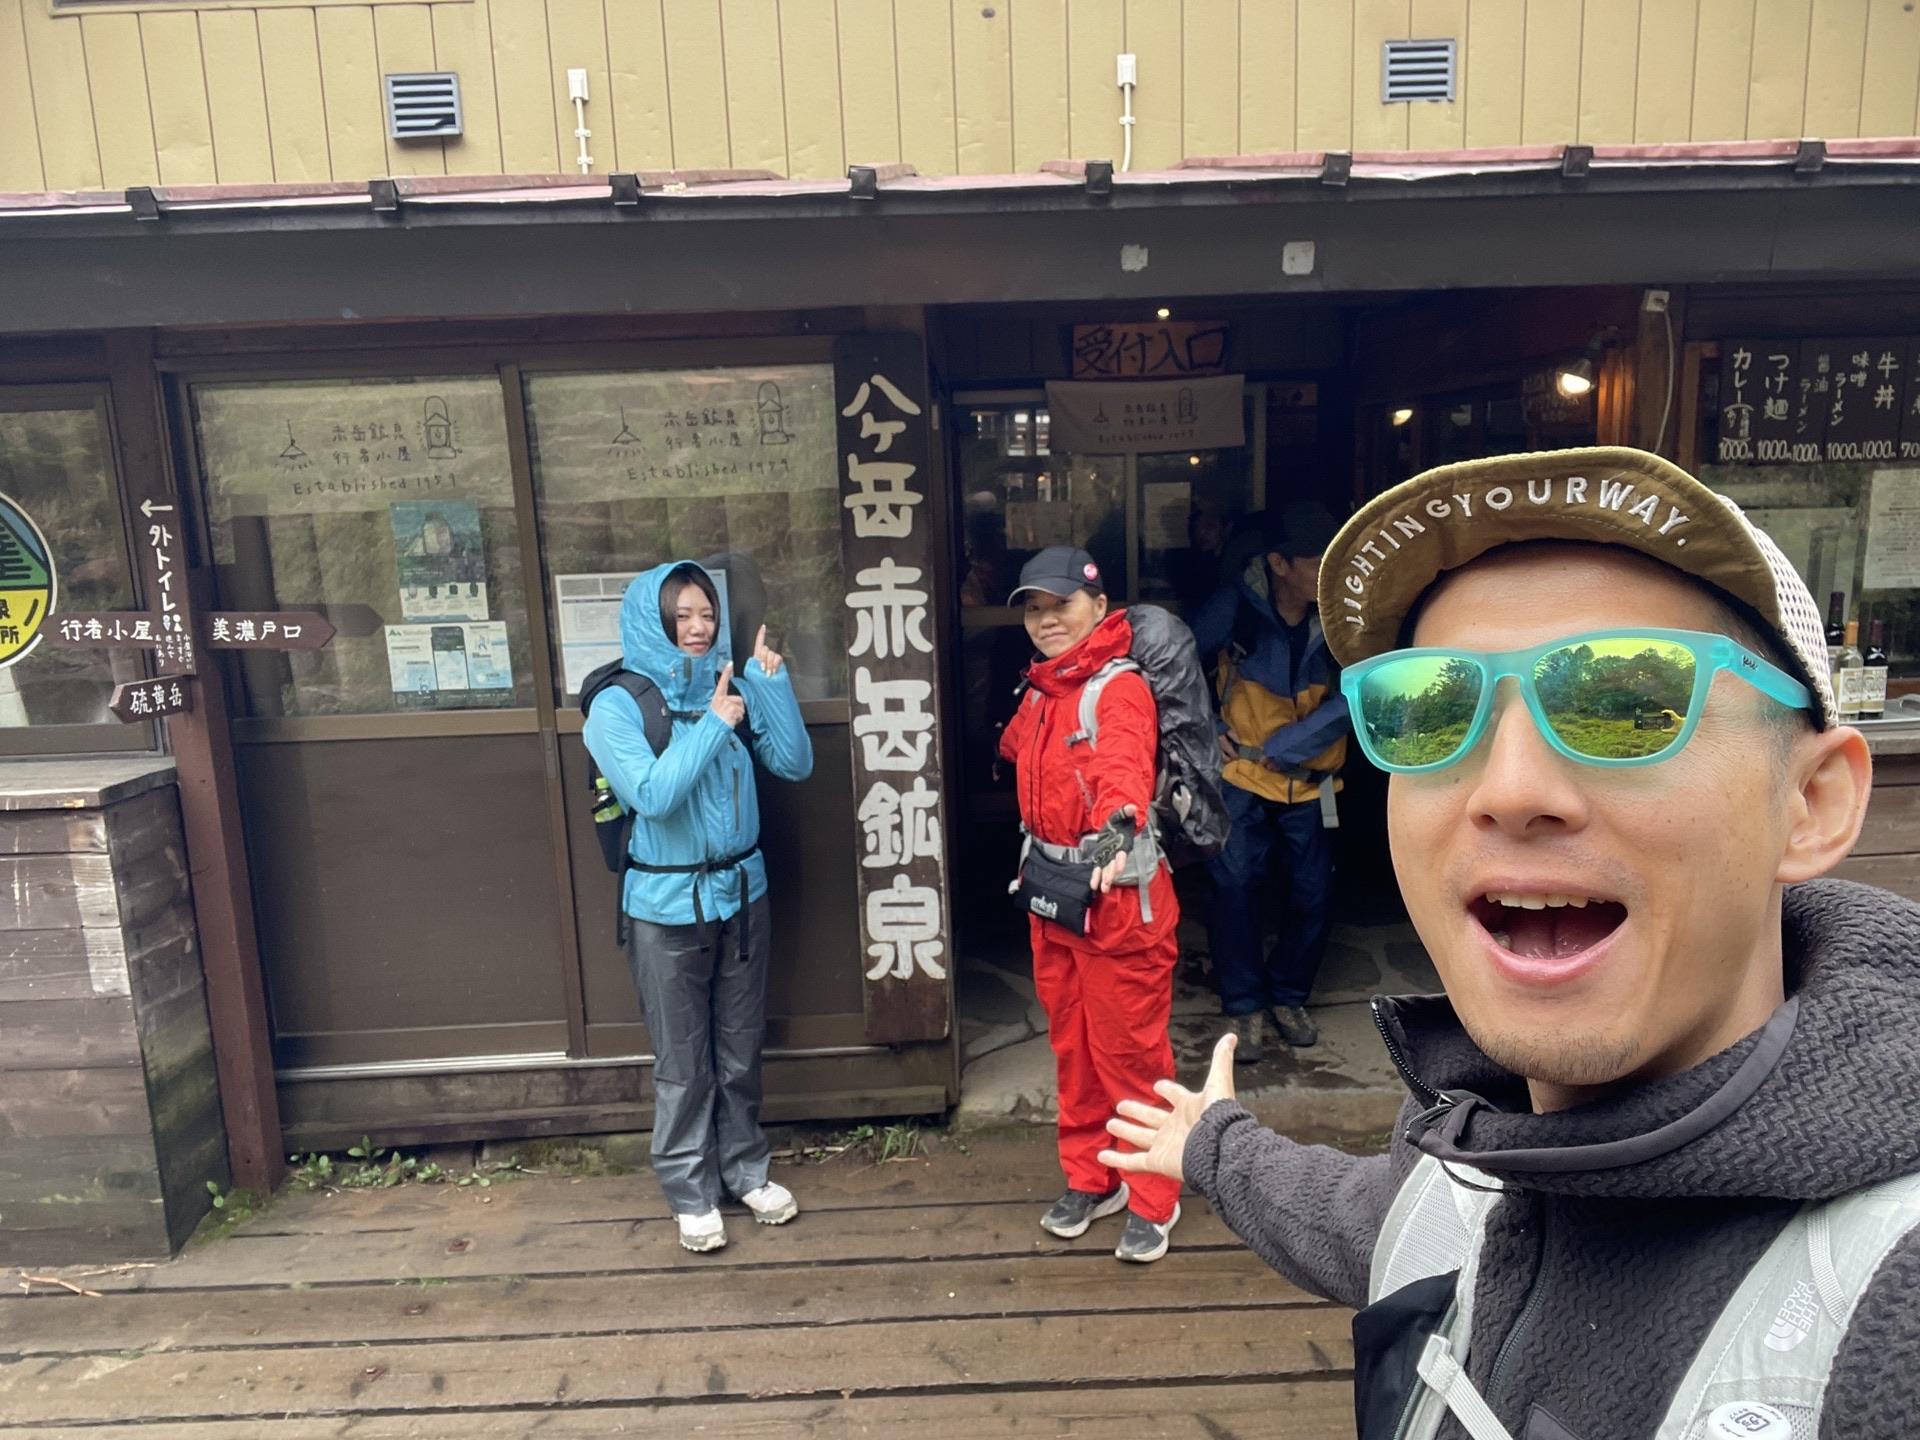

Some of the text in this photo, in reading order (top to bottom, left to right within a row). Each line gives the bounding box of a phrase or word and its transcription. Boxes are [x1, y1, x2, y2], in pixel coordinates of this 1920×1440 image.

[1074, 326, 1229, 375] 受付入口
[1831, 372, 1847, 426] ラーメン
[1874, 351, 1899, 410] 牛丼
[149, 524, 176, 612] 外トイレ
[60, 618, 153, 641] 行者小屋
[212, 618, 302, 642] 美濃戸口
[130, 683, 183, 714] 硫黄岳
[1777, 1280, 1807, 1320] FACE
[1789, 1282, 1817, 1326] ORTH
[1799, 1302, 1820, 1333] THE
